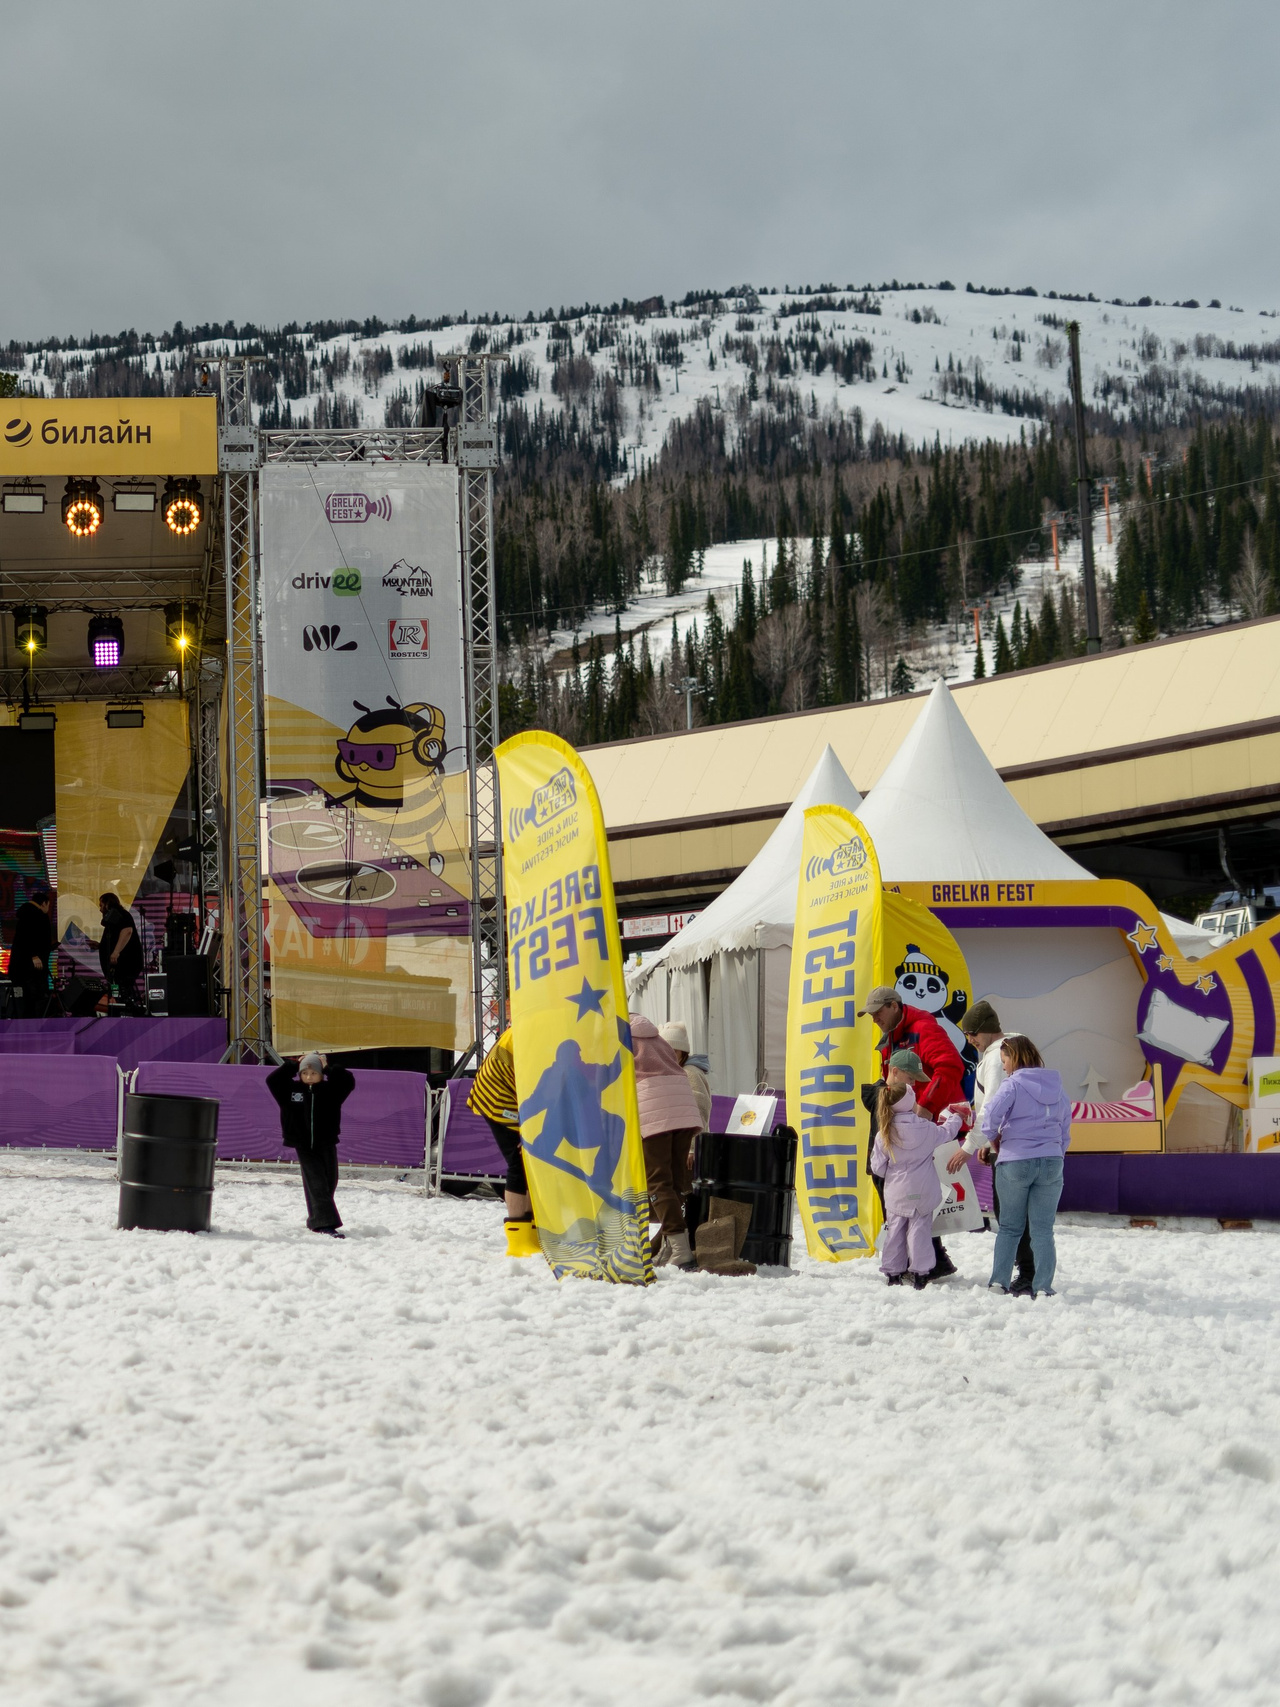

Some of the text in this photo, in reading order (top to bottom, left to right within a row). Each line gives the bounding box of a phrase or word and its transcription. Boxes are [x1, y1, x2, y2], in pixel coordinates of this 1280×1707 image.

[41, 418, 151, 445] билайн
[332, 497, 363, 508] GRELKA
[332, 509, 353, 519] FEST
[292, 573, 362, 592] drivee
[382, 577, 432, 588] MOUNTAIN
[410, 587, 433, 597] MAN
[932, 884, 1035, 902] GRELKA FEST
